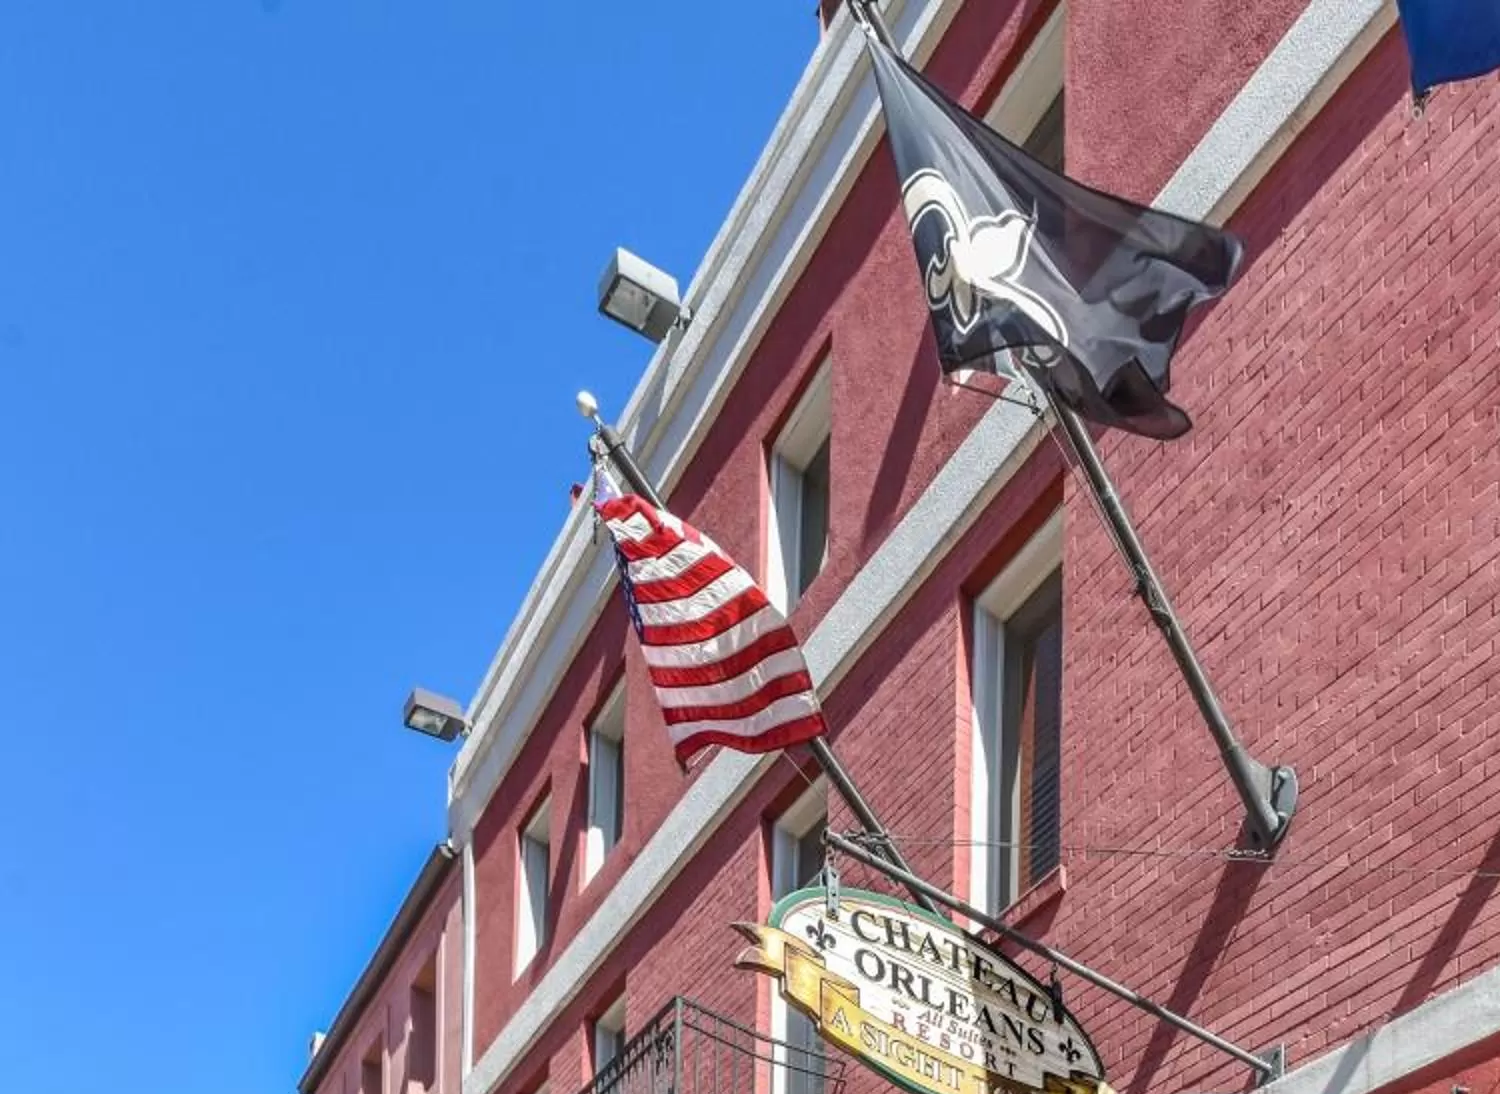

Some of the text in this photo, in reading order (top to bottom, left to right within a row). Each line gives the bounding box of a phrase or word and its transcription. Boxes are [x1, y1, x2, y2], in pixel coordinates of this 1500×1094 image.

[850, 909, 1050, 1026] CHATEAU
[854, 948, 1046, 1056] ORLEANS
[830, 1006, 853, 1037] A
[858, 1019, 966, 1092] SIGHT
[891, 1011, 1018, 1078] RESORT
[917, 1007, 993, 1050] All Suites
